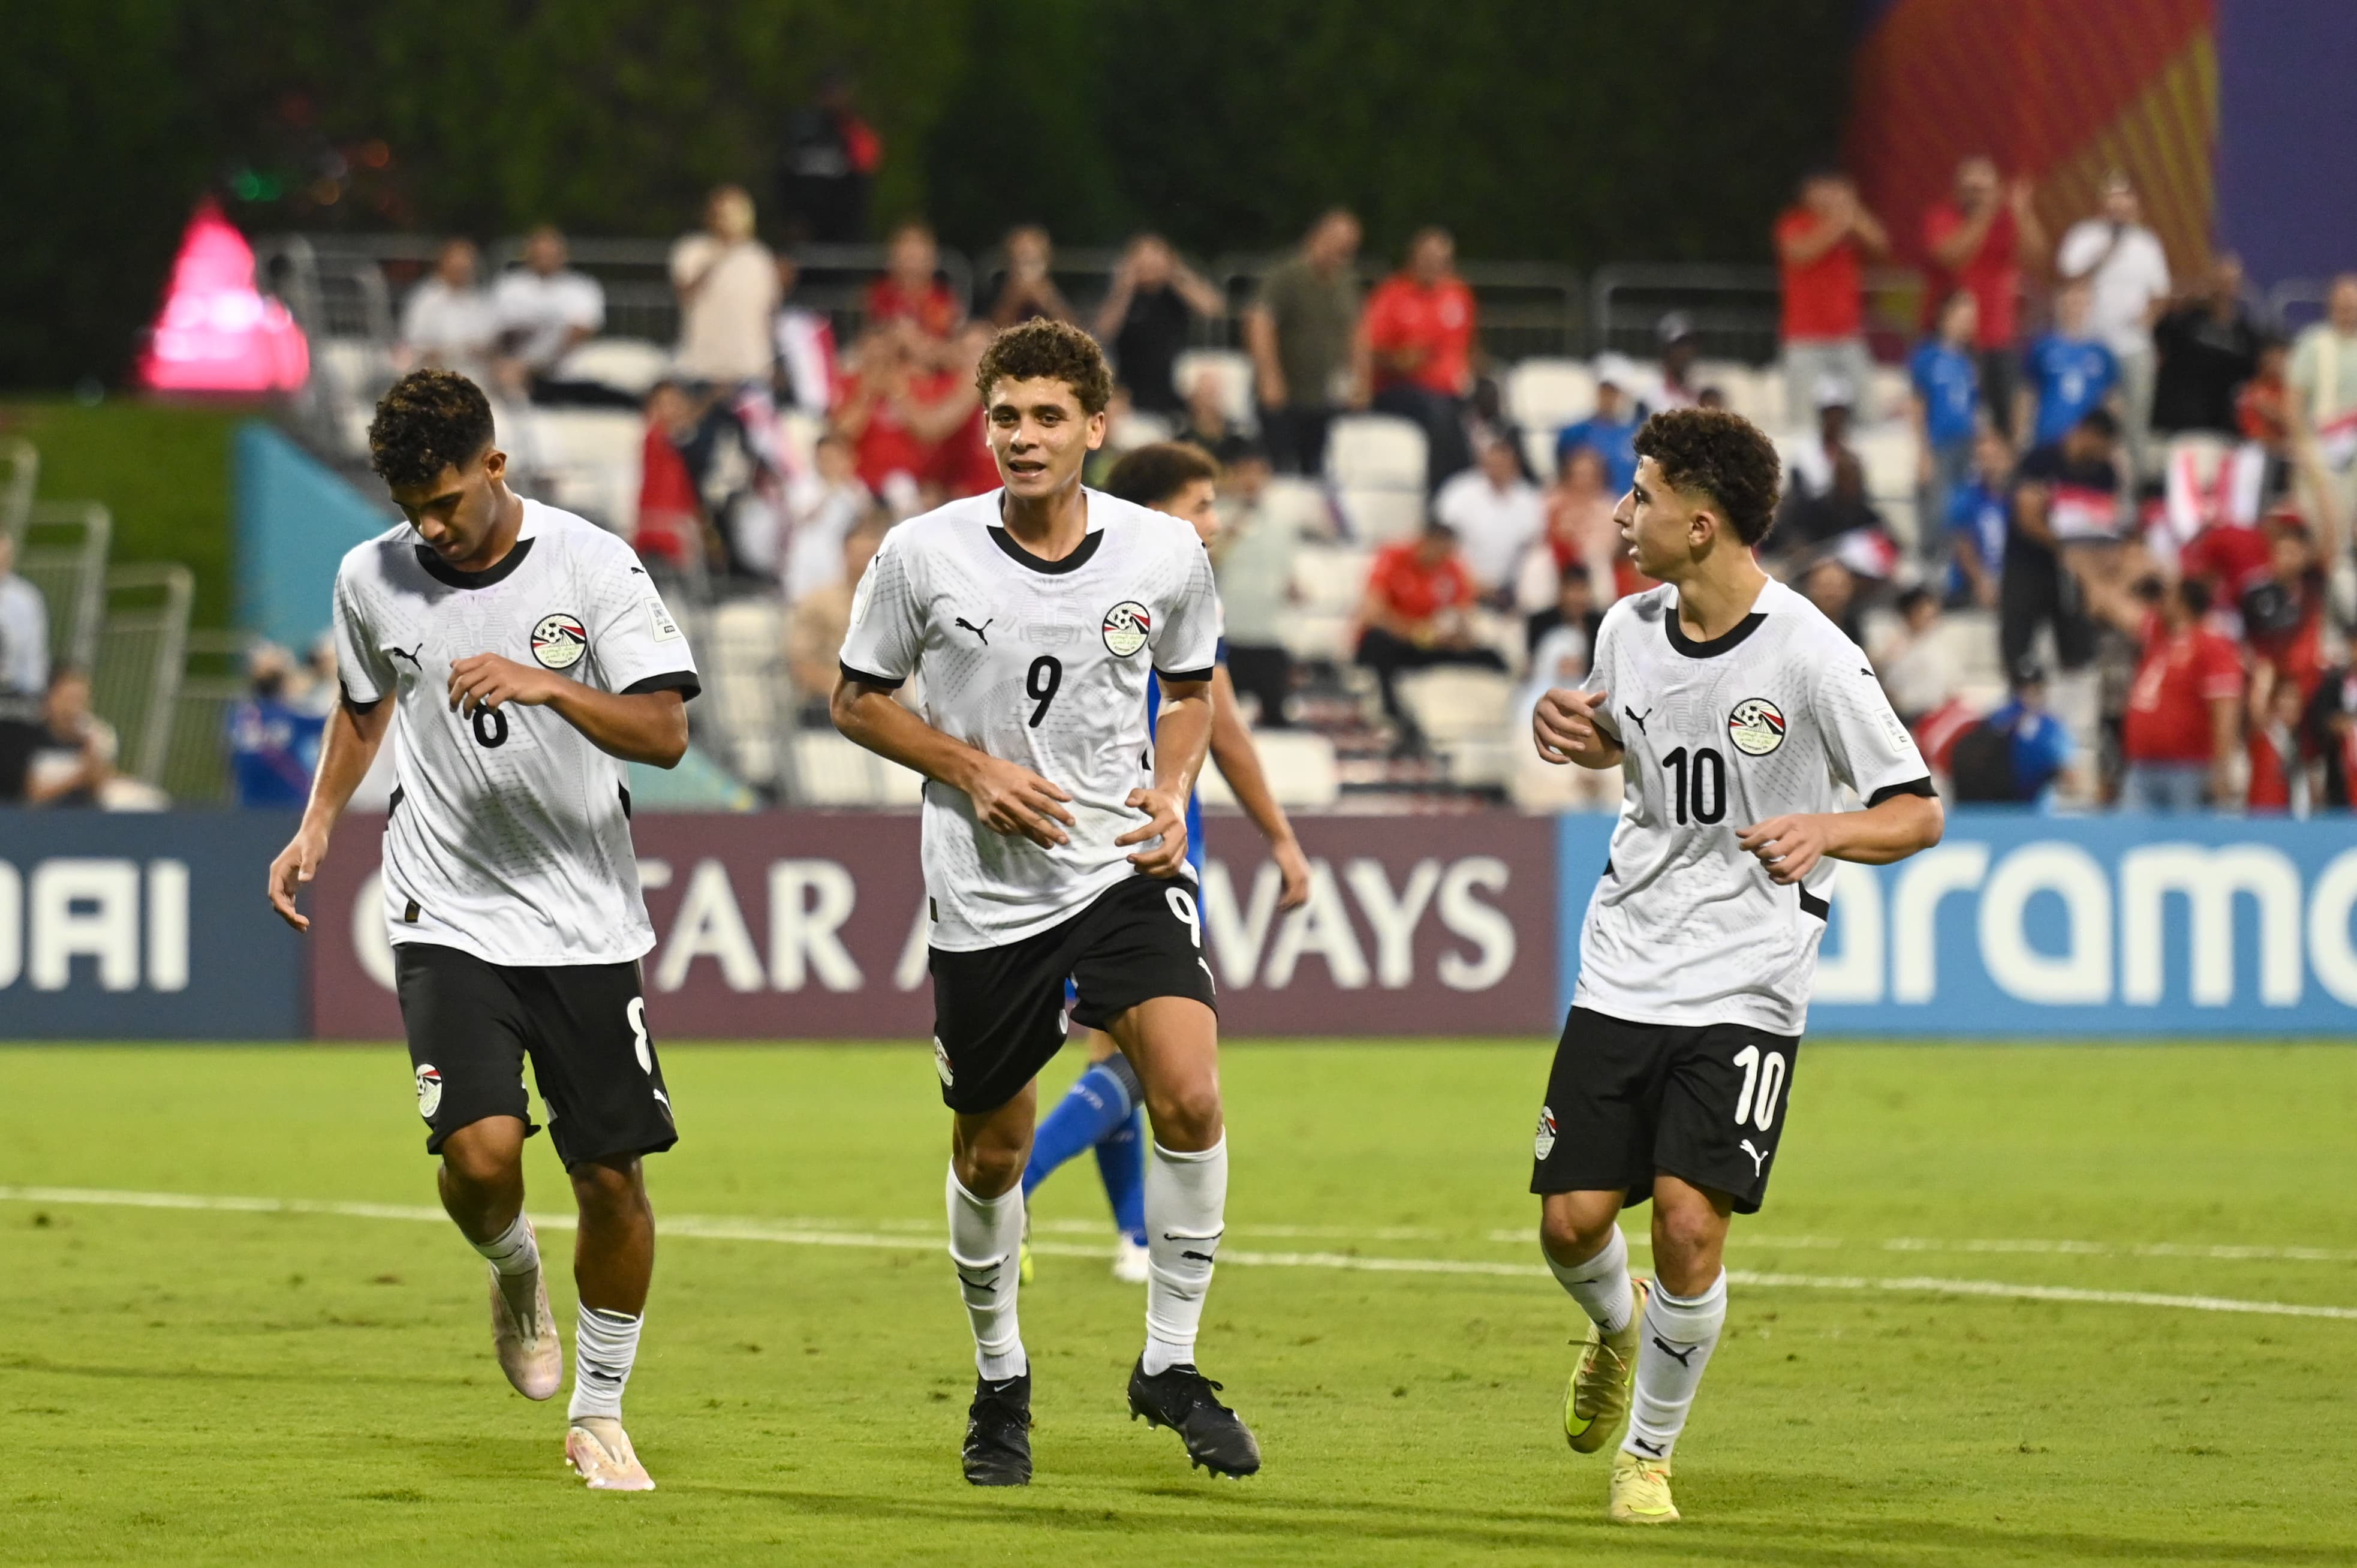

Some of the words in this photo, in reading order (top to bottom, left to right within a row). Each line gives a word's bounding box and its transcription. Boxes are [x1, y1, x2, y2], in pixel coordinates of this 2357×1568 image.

[1027, 655, 1062, 728] 9
[1663, 747, 1726, 825] 10
[0, 859, 191, 993] AI
[1165, 887, 1200, 948] 9
[1733, 1045, 1786, 1131] 10
